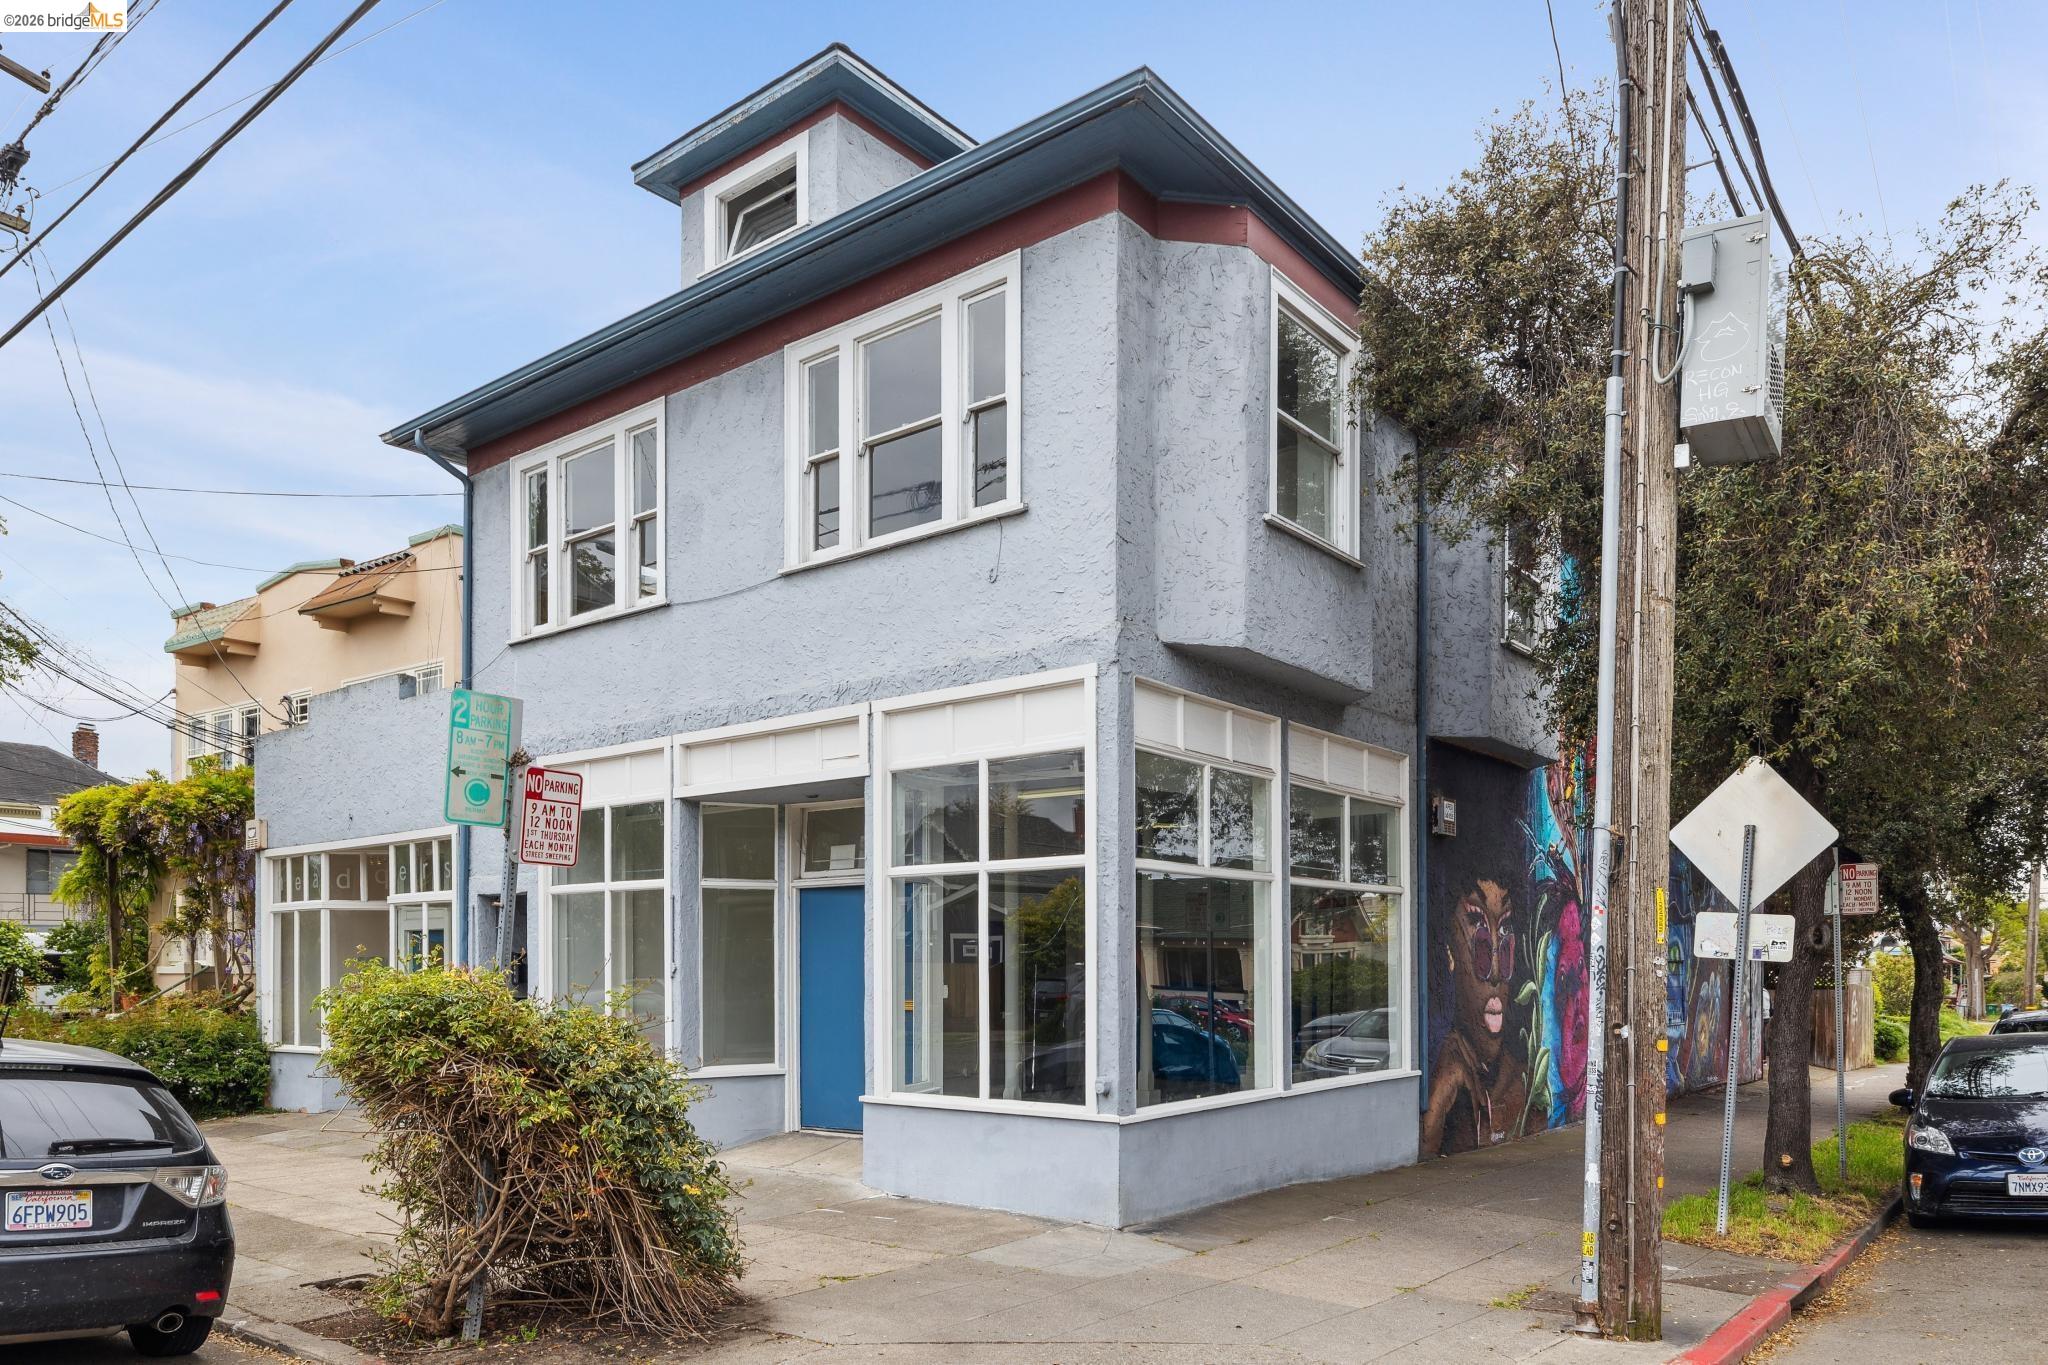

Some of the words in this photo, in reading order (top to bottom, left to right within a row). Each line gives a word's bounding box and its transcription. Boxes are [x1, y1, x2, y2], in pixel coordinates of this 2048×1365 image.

[1685, 364, 1742, 388] RECON
[454, 699, 467, 723] 2
[476, 701, 504, 714] HOUR
[471, 715, 507, 731] PARKING
[456, 730, 463, 744] 8
[465, 735, 476, 744] AM
[485, 735, 493, 748] 7
[494, 741, 505, 749] PM
[527, 774, 543, 793] NO
[544, 780, 579, 795] PARKING
[531, 803, 538, 814] 9
[542, 804, 556, 817] AM
[561, 807, 572, 818] TO
[530, 816, 540, 828] 12
[545, 818, 572, 831] NOON
[527, 828, 537, 838] 1ST
[541, 830, 575, 842] THURSDAY
[525, 840, 544, 850] EACH
[548, 842, 573, 853] MONTH
[525, 851, 543, 859] STREET
[546, 852, 571, 861] SWEEPING
[1843, 868, 1855, 880] NO
[13, 1203, 87, 1223] 6FPW905
